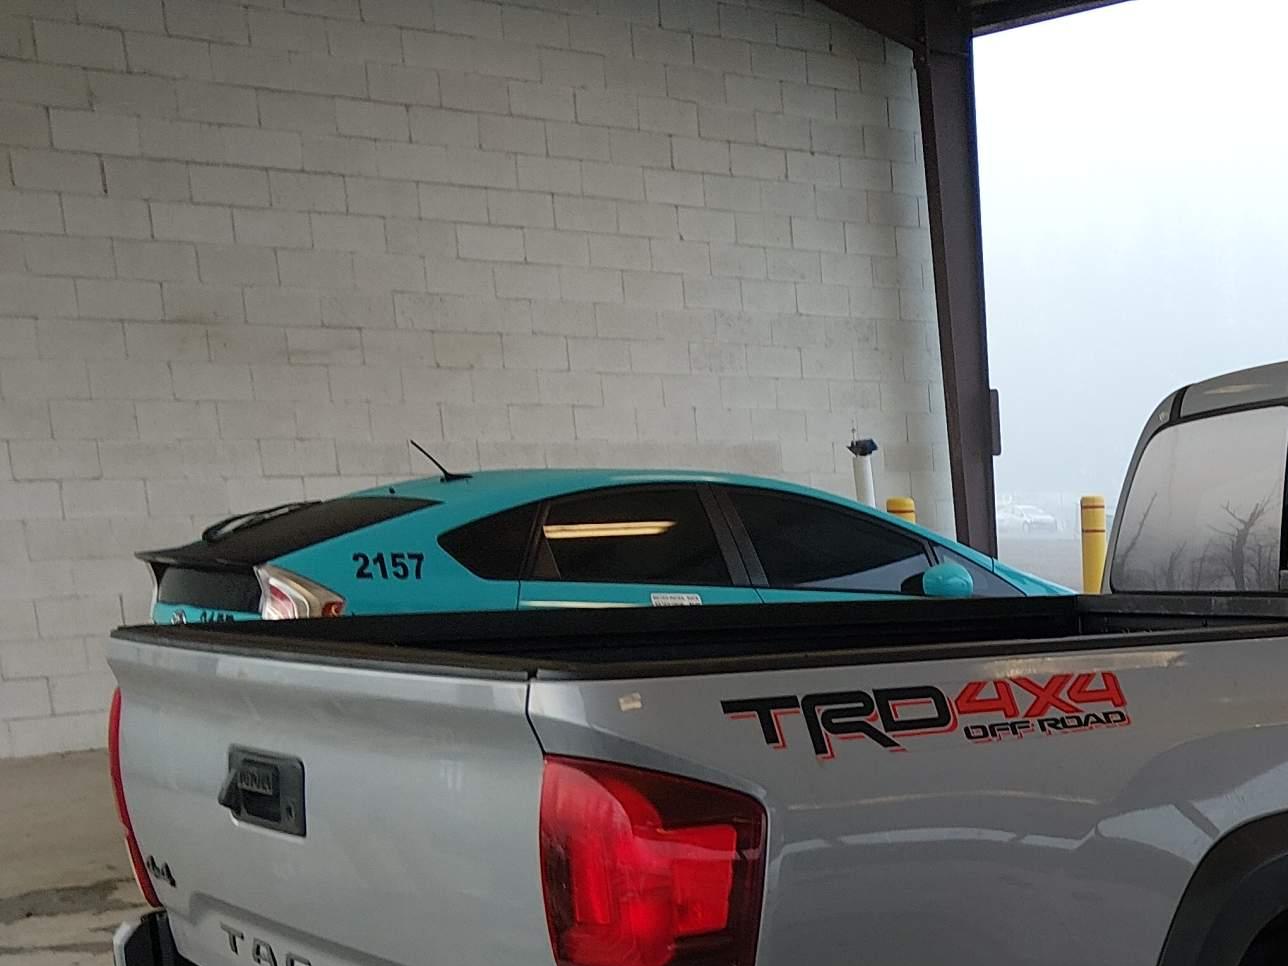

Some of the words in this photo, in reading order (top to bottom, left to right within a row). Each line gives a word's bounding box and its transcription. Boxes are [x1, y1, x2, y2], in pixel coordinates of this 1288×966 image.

[352, 552, 424, 580] 2157
[720, 686, 957, 760] TRD
[964, 720, 1035, 745] OFF
[1037, 710, 1131, 737] ROAD
